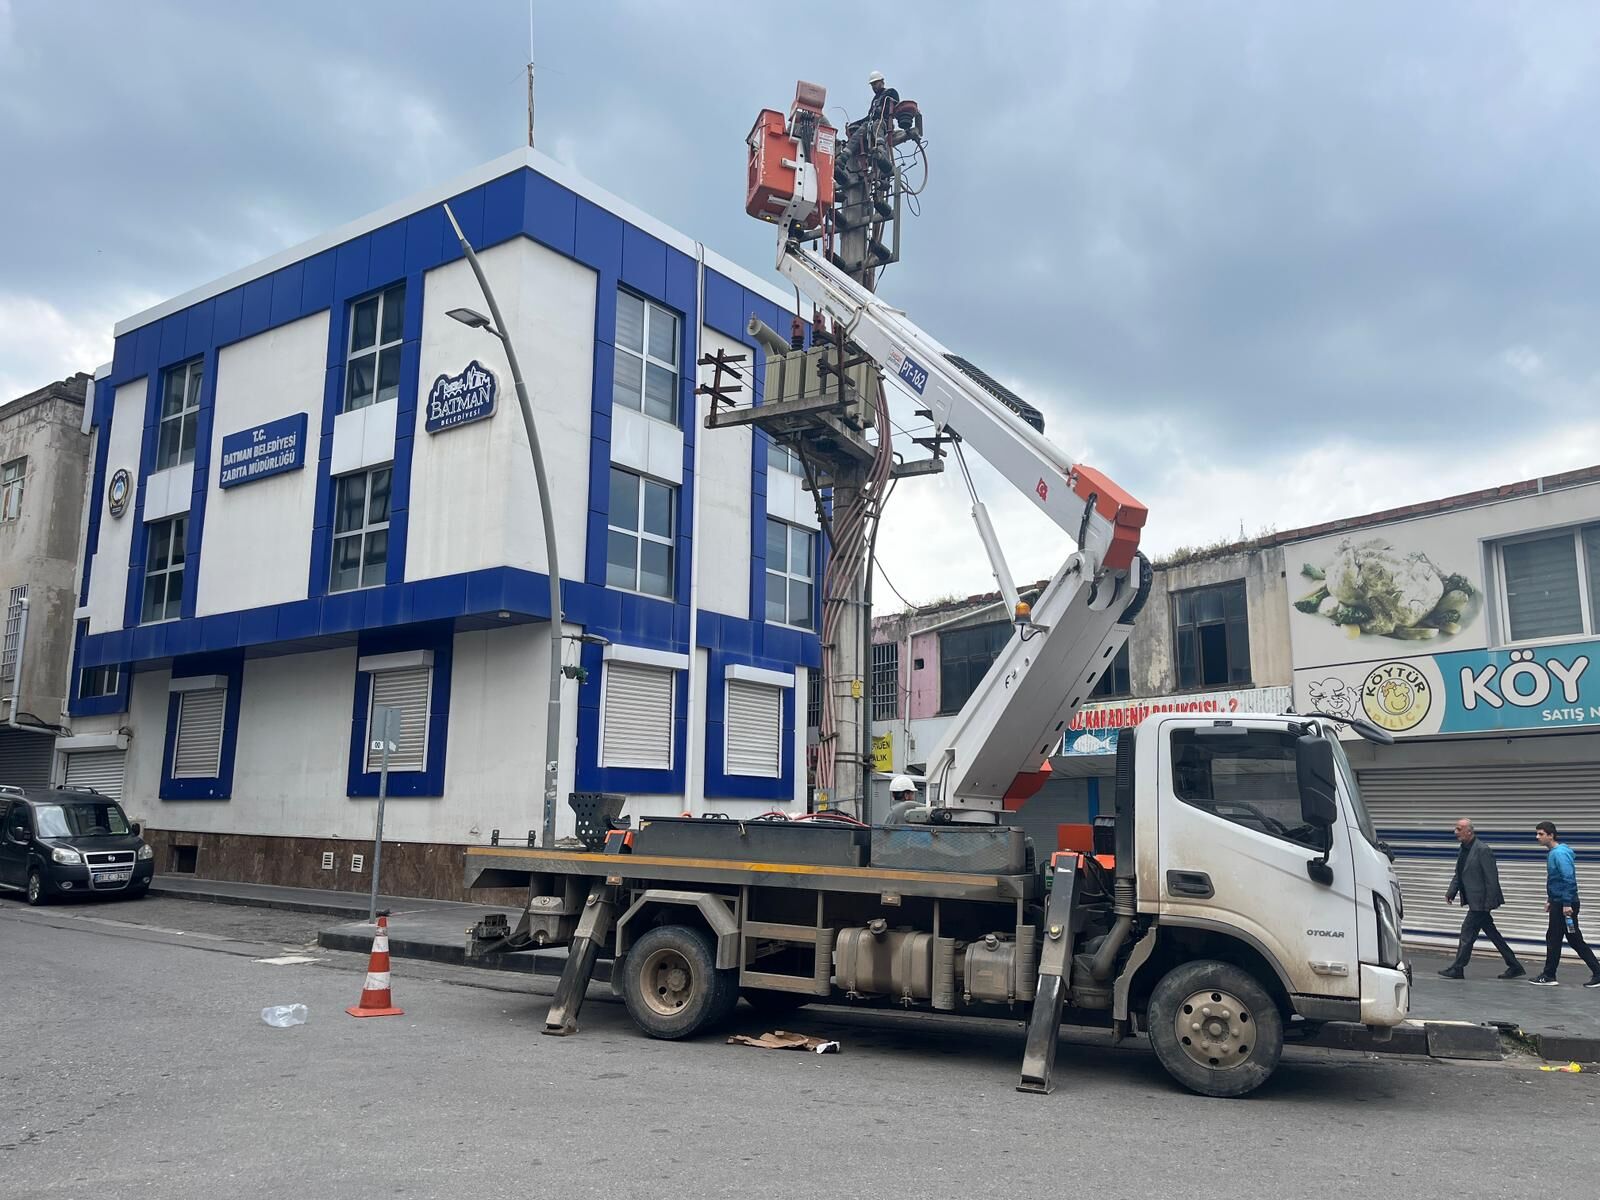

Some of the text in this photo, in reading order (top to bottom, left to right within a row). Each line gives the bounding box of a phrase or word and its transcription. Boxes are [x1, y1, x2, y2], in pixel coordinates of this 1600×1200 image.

[901, 361, 926, 389] PT-162
[430, 387, 491, 421] BATMAN
[441, 408, 481, 426] BELEDİYESİ
[223, 431, 296, 466] BATMAN BELEDİYESİ
[252, 429, 267, 443] T.C.
[221, 449, 295, 483] ZABITA MÜDÜRLÜĞÜ
[1366, 667, 1426, 697] KÖYTÜR
[1460, 649, 1590, 711] KÖY
[1542, 706, 1600, 721] SATIŞ N
[1306, 929, 1345, 938] OTOKAR
